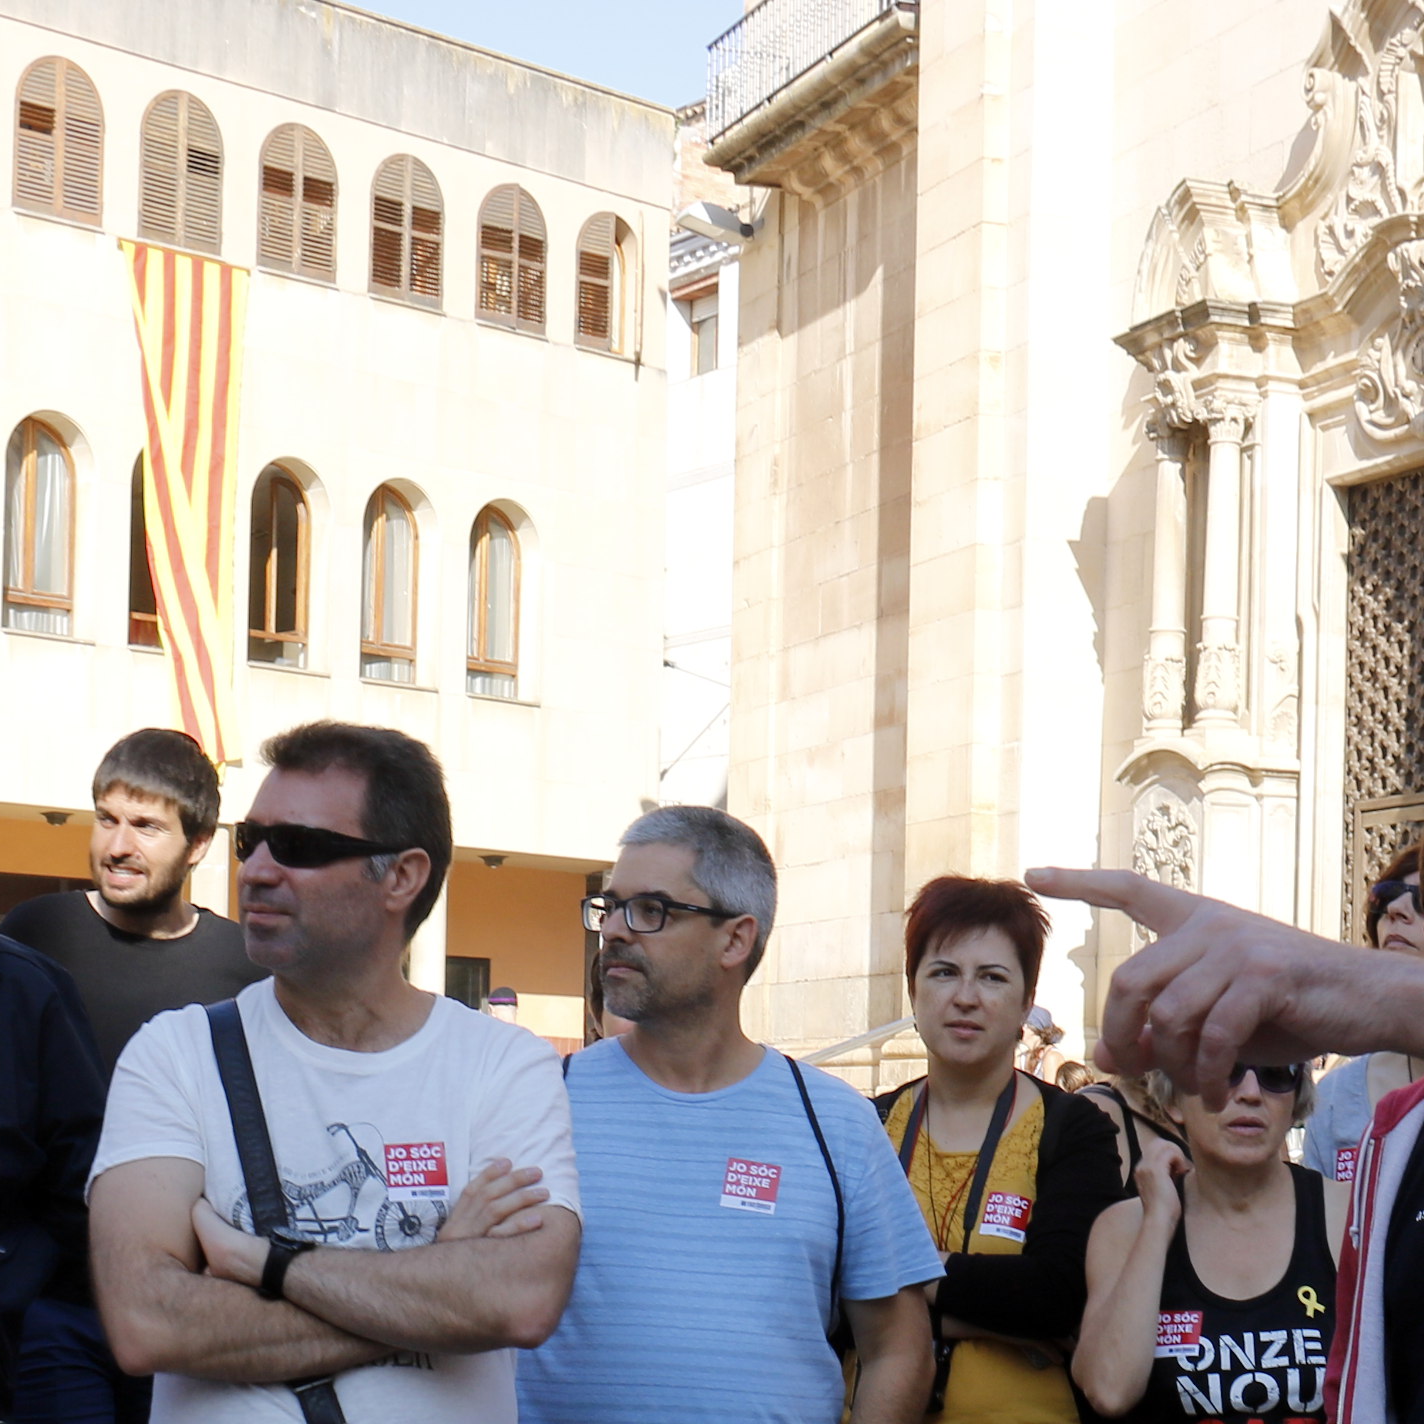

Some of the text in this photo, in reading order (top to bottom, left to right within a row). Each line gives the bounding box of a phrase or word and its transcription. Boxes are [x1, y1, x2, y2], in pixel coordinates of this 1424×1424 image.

[387, 1144, 442, 1160] JO SÓC
[387, 1159, 437, 1173] D'EIXE
[729, 1162, 778, 1178] JO SÓC
[727, 1172, 771, 1188] D'EIXE
[988, 1194, 1029, 1210] JO SÓC
[986, 1203, 1023, 1218] D'EIXE
[1174, 1311, 1200, 1323] SÓC
[1176, 1328, 1327, 1372] ONZE
[1176, 1367, 1326, 1416] NOU
